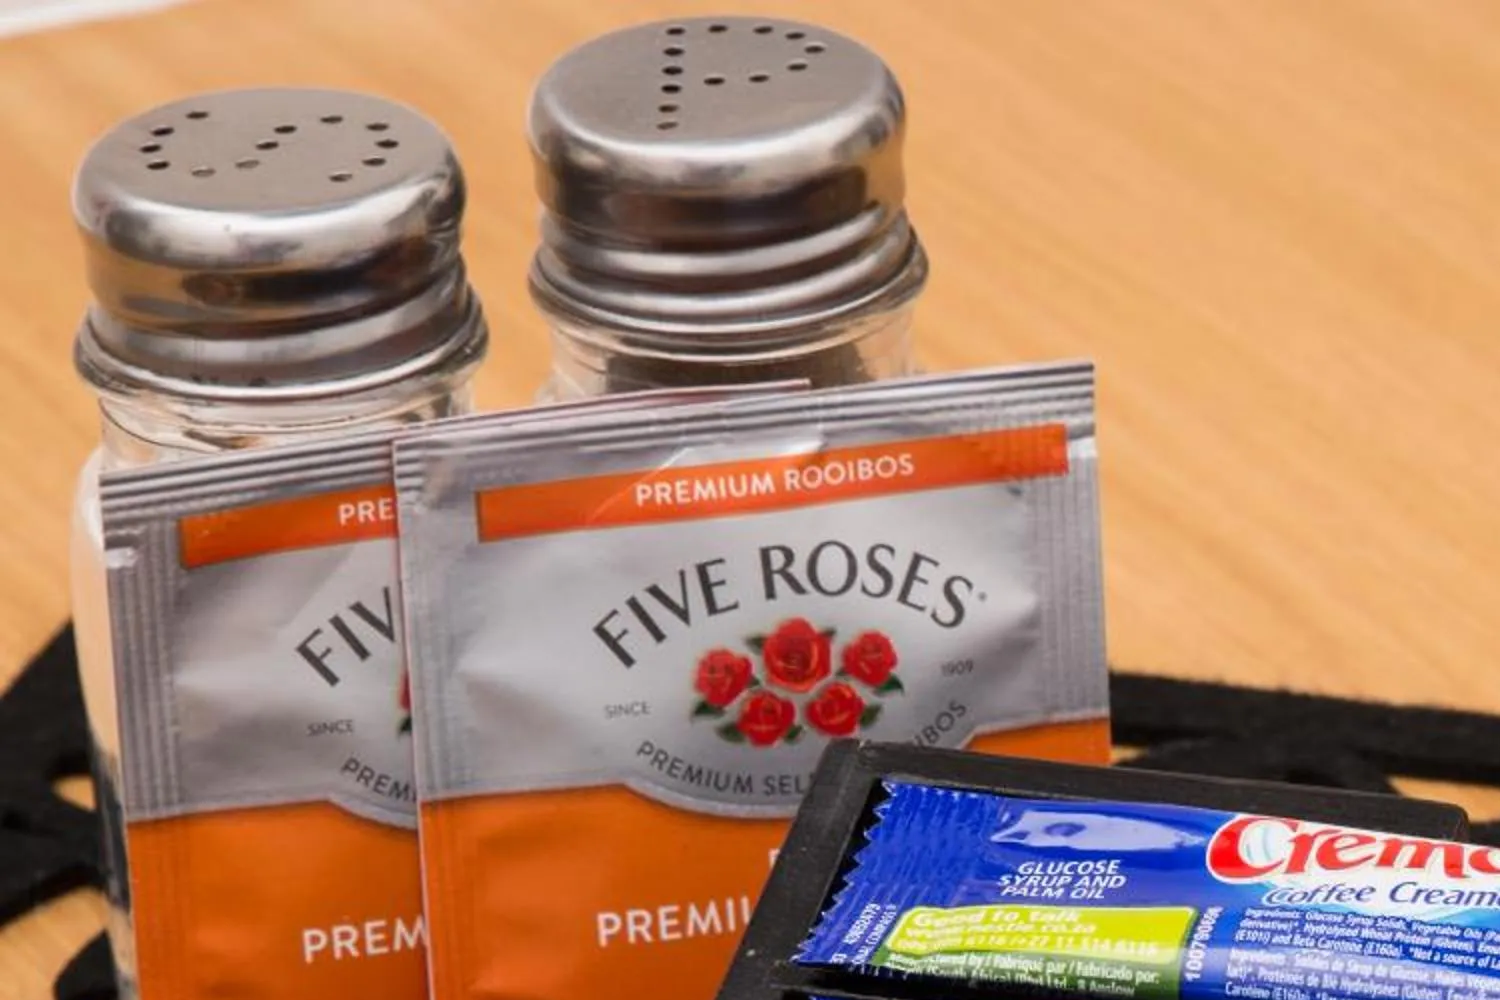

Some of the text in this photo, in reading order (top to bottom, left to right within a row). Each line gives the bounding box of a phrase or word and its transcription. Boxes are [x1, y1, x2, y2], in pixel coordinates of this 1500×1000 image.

[635, 453, 915, 506] PREMIUM ROOIBOS
[592, 540, 975, 669] FIVE ROSES
[294, 586, 396, 687] FIV
[306, 719, 354, 737] SINCE
[604, 701, 651, 719] SINCE
[340, 757, 418, 802] PREM
[636, 741, 755, 795] PREMIUM
[997, 874, 1127, 889] SYRUP AND
[1017, 859, 1121, 876] GLUCOSE
[1001, 886, 1106, 899] PALM OIL
[1264, 880, 1376, 906] Coffee
[302, 914, 428, 963] PREM
[596, 896, 751, 947] PREMI
